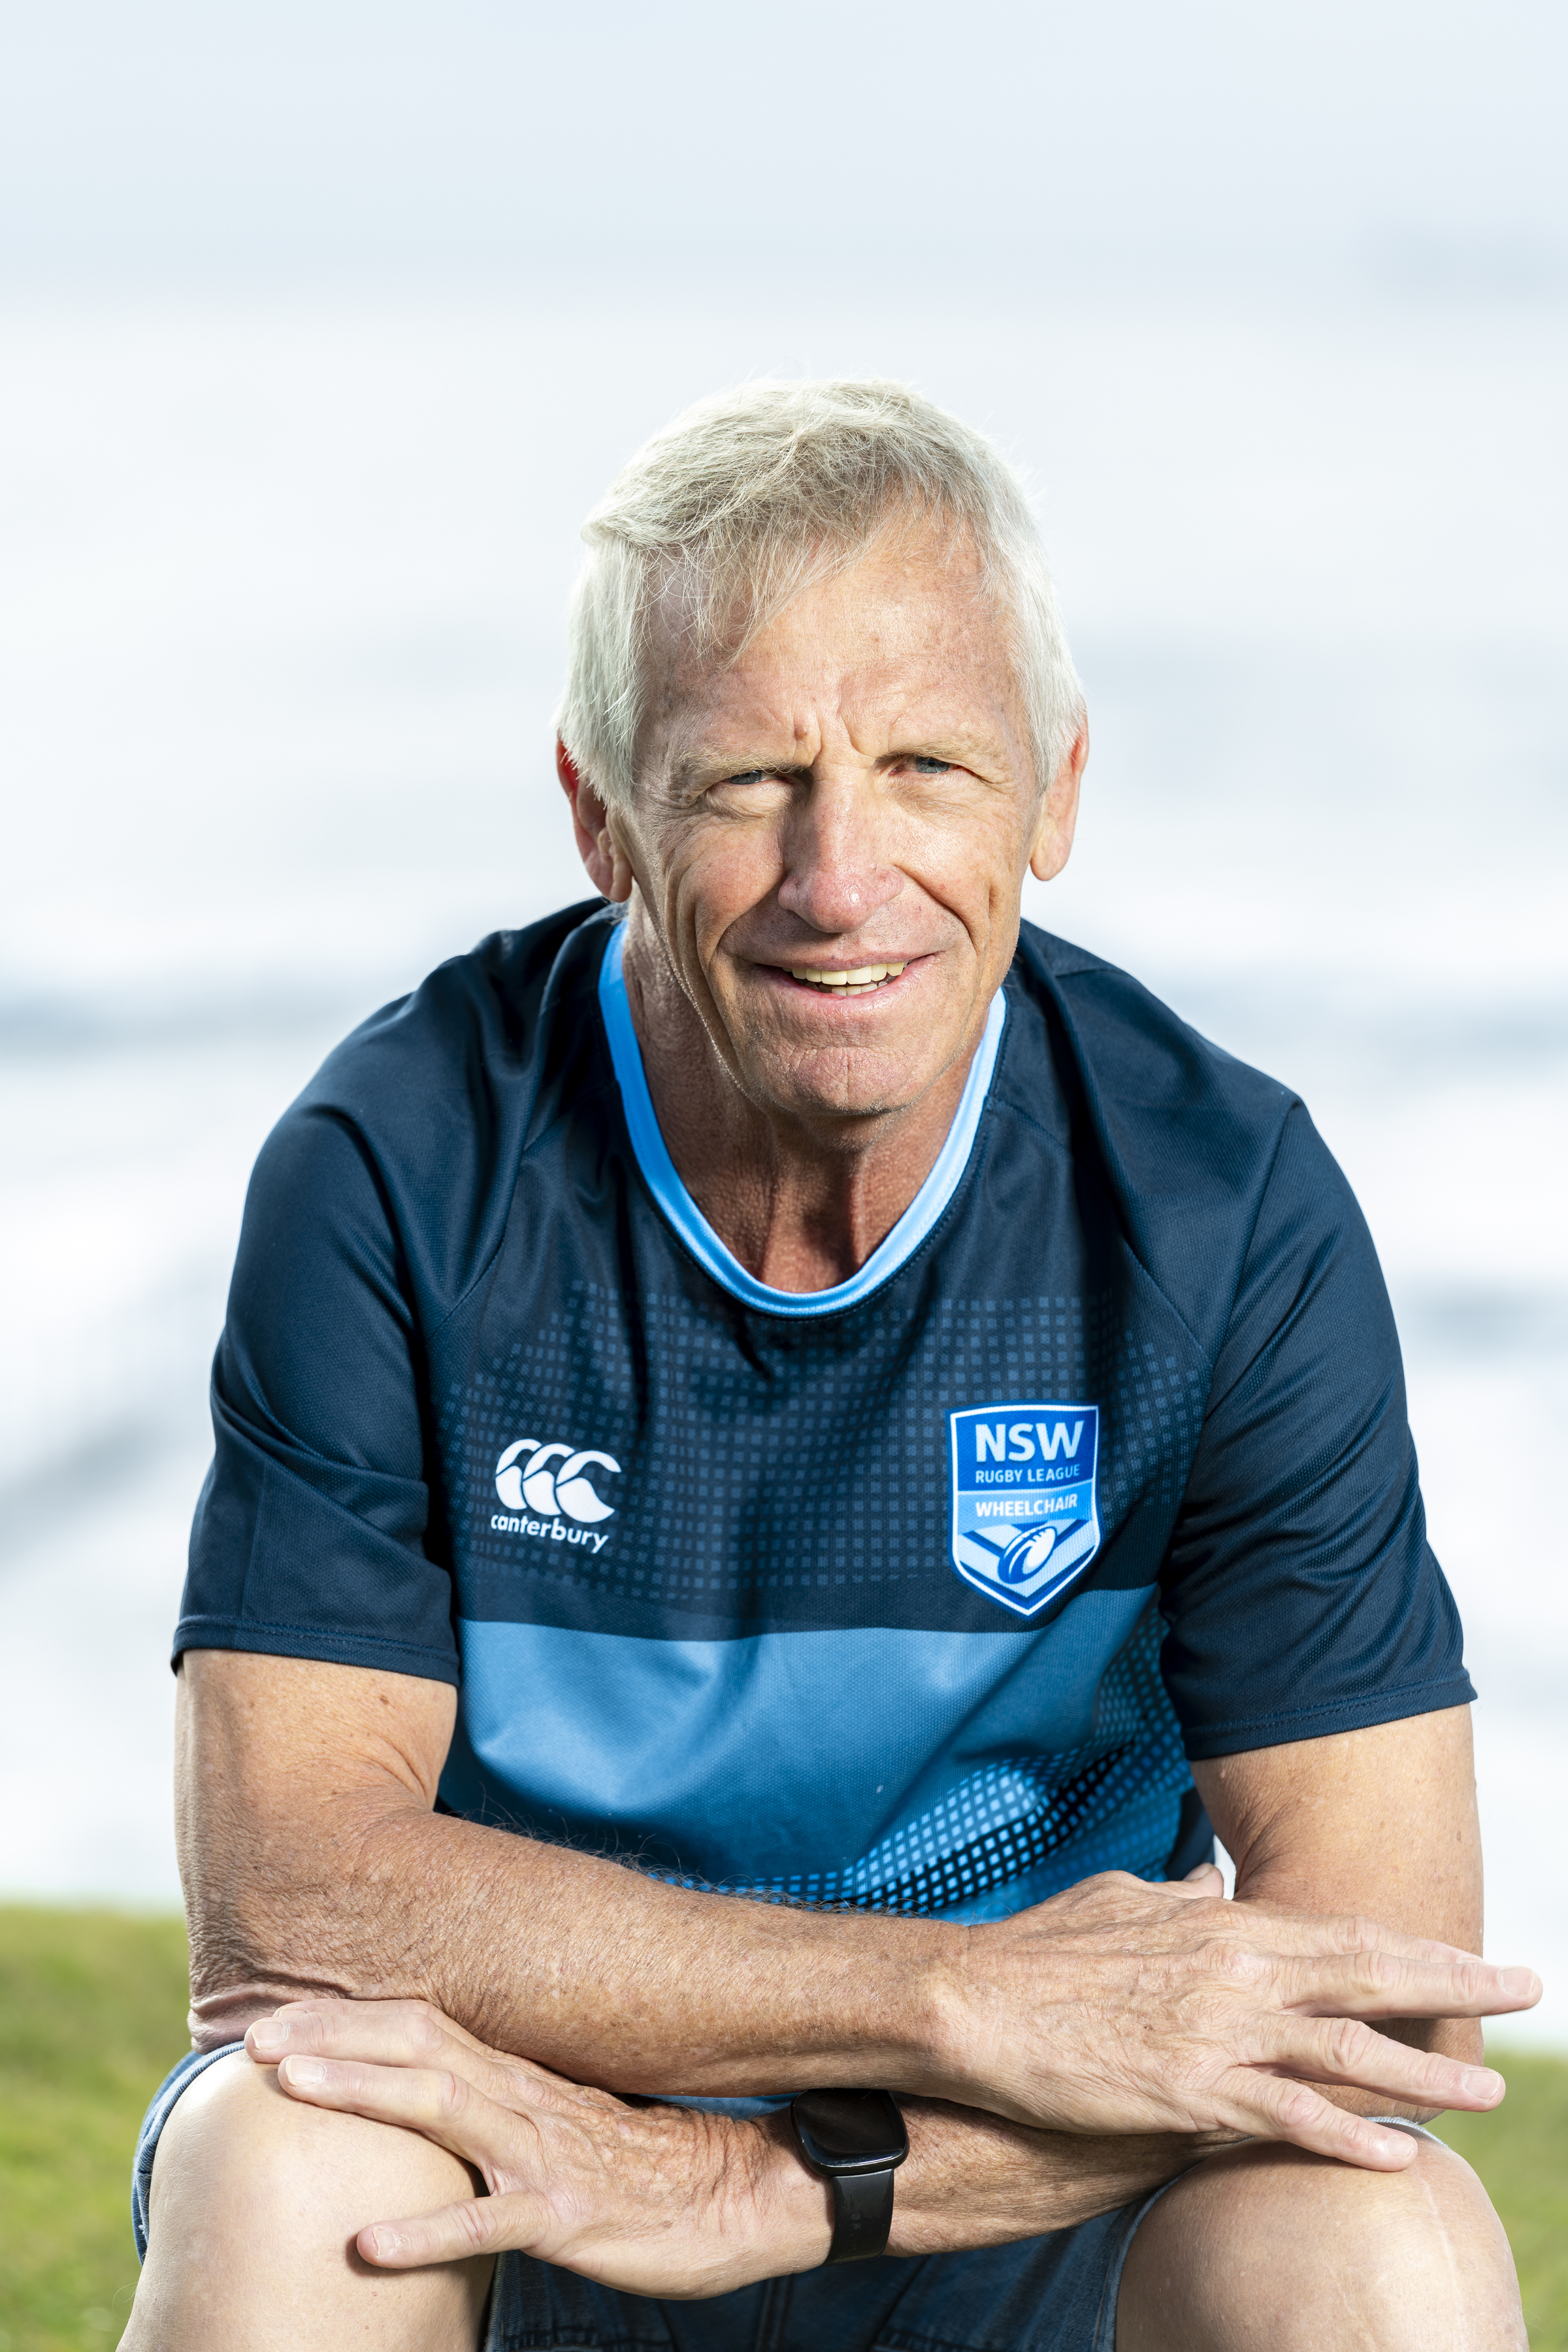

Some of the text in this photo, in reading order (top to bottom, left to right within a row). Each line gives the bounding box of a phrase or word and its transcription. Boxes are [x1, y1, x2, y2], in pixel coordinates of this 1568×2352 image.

[975, 1420, 1085, 1462] NSW
[975, 1463, 1081, 1483] RUGBY LEAGUE
[975, 1494, 1078, 1517] WHEELCHAIR
[491, 1514, 609, 1554] canterbury
